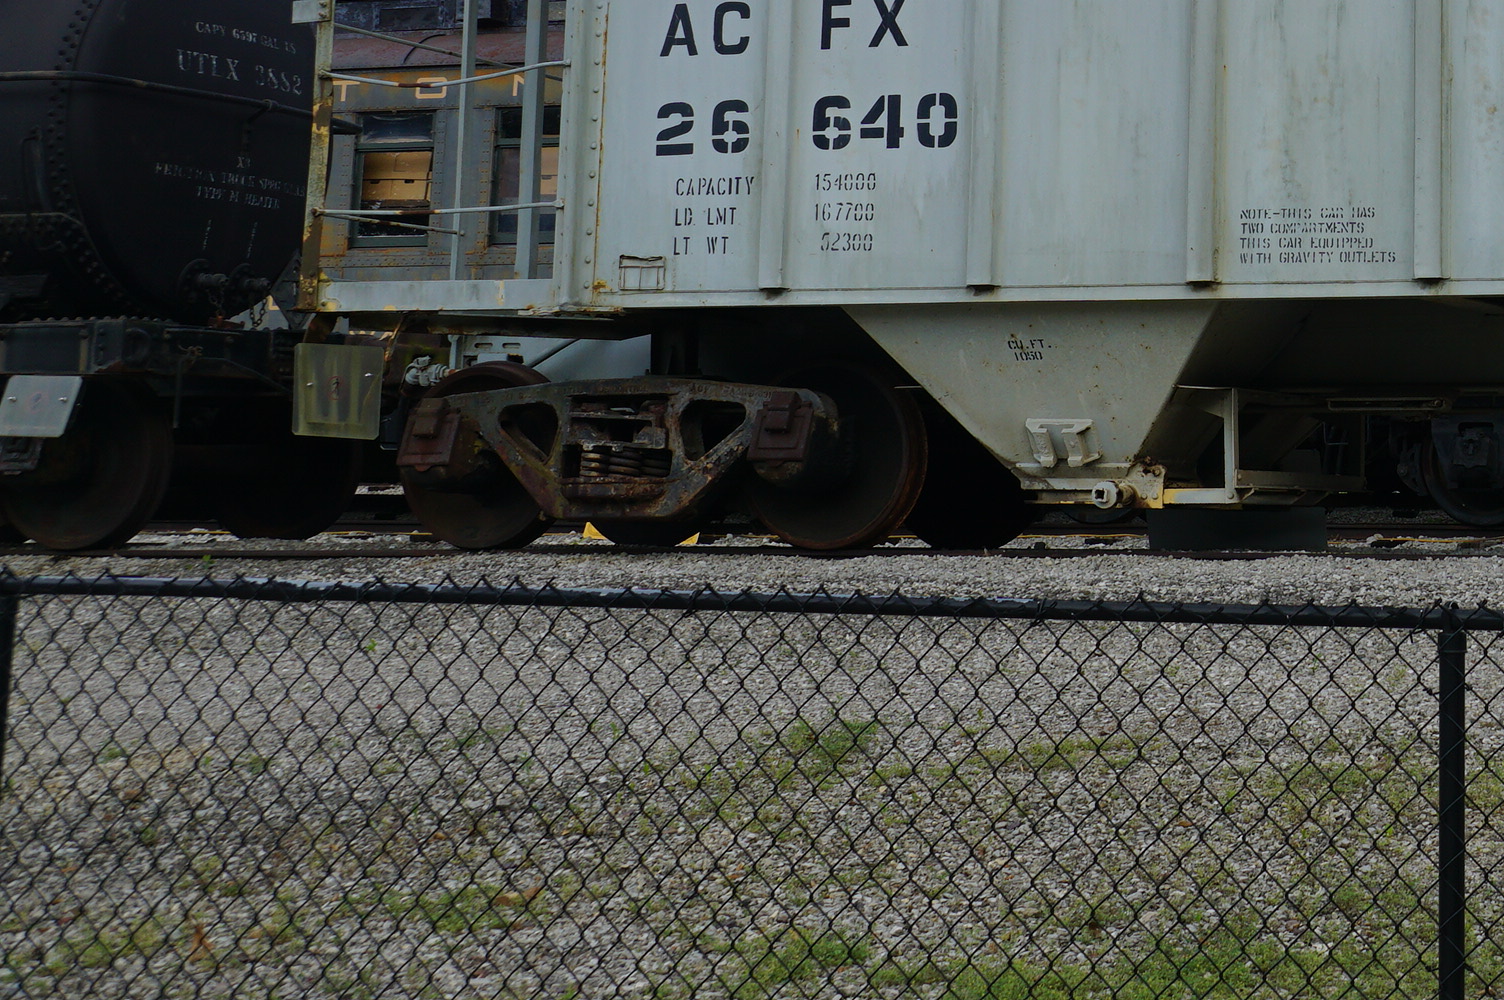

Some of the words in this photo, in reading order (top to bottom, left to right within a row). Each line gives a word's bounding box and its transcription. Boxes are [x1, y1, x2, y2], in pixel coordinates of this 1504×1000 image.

[660, 1, 751, 57] AC
[176, 48, 240, 81] UTLX
[655, 99, 750, 156] 26
[812, 92, 958, 150] 640
[675, 176, 755, 196] CAPACITY
[815, 172, 876, 191] 154000
[815, 203, 875, 221] 167700
[1320, 207, 1344, 219] CAR
[1352, 207, 1376, 218] HAS
[1241, 222, 1264, 234] TWO
[1270, 221, 1365, 234] COMPARTMENTS
[820, 232, 873, 251] 52300
[1240, 237, 1271, 249] THIS
[1278, 236, 1302, 249] CAR
[1310, 236, 1374, 249] EQUIPPED
[1240, 252, 1272, 264] WITH
[1279, 251, 1334, 264] GRAVITY
[1339, 250, 1396, 263] OUTLETS
[1014, 351, 1043, 361] 1050
